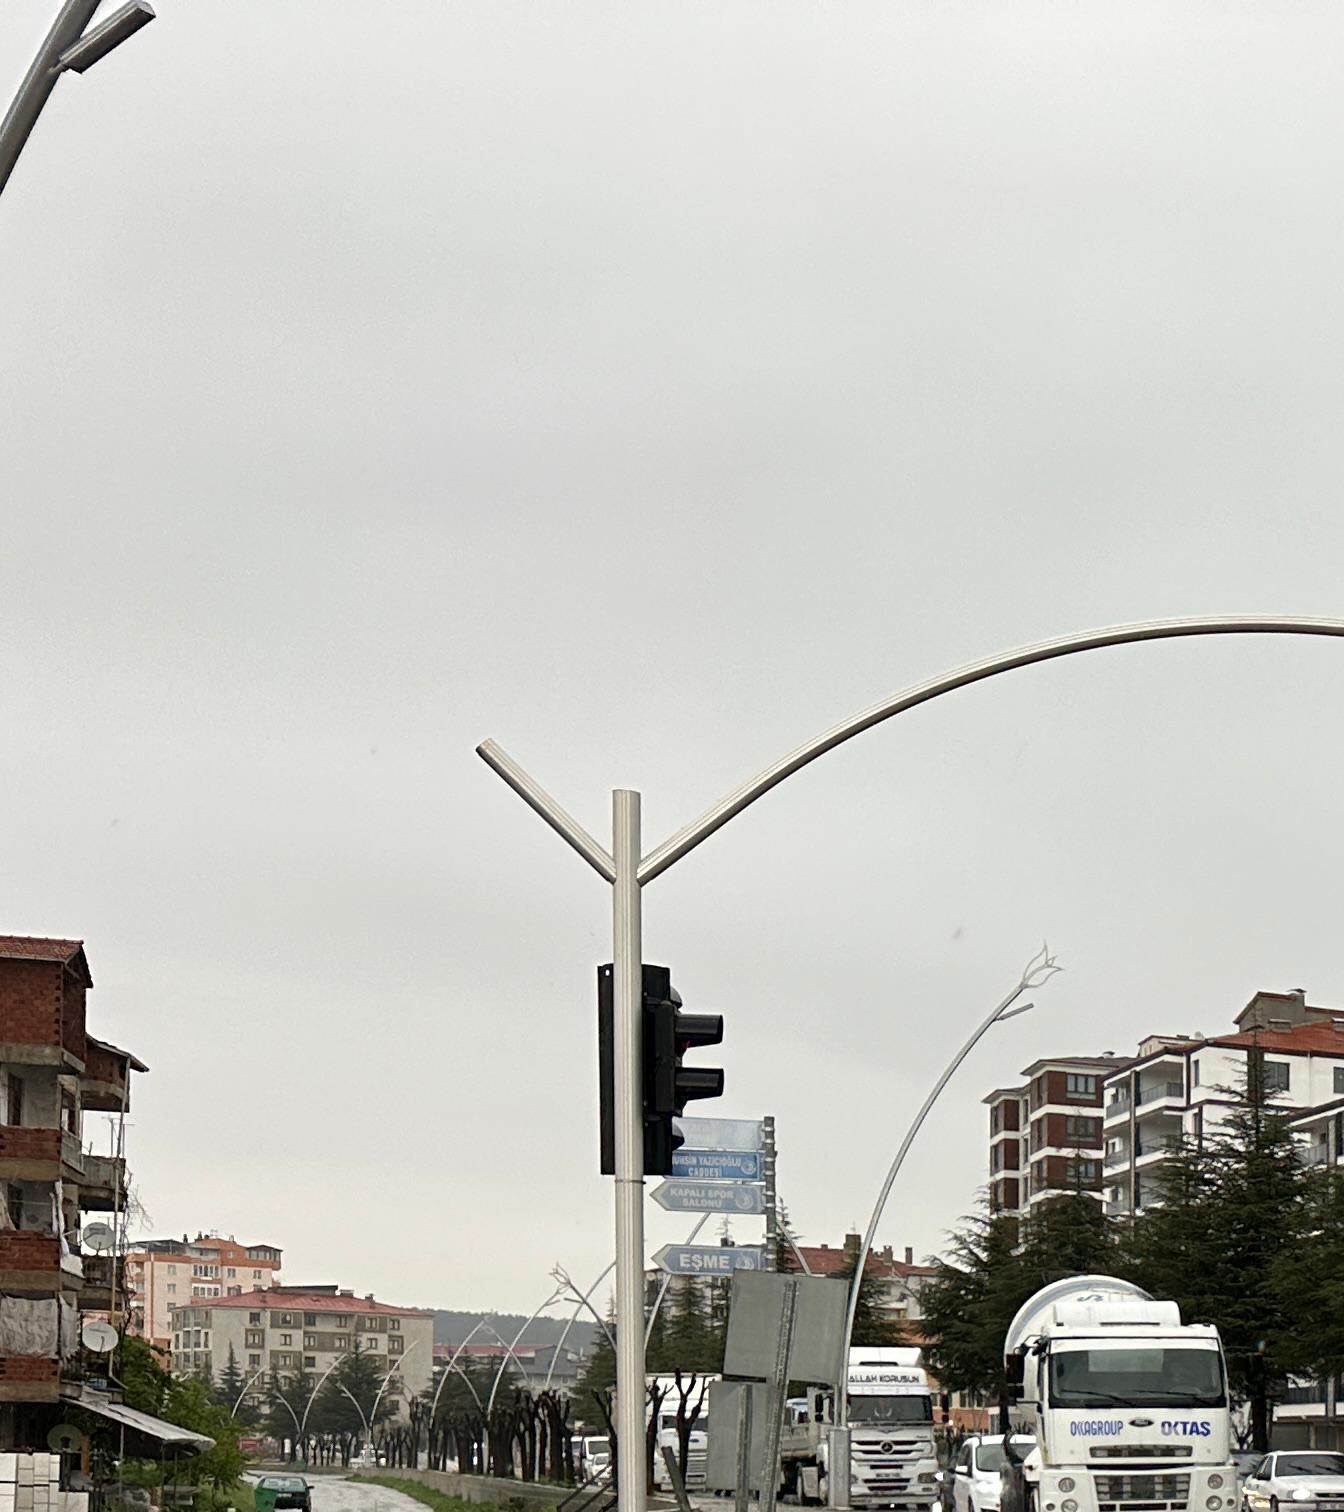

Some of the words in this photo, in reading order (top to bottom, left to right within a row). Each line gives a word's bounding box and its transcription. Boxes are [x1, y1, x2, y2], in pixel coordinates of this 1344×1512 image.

[670, 1187, 704, 1197] KAPALI
[707, 1189, 734, 1199] SPOR
[682, 1198, 720, 1208] SALONU
[679, 1254, 730, 1271] EŞME
[849, 1375, 877, 1383] ALLAH
[880, 1375, 920, 1383] KORUSUN
